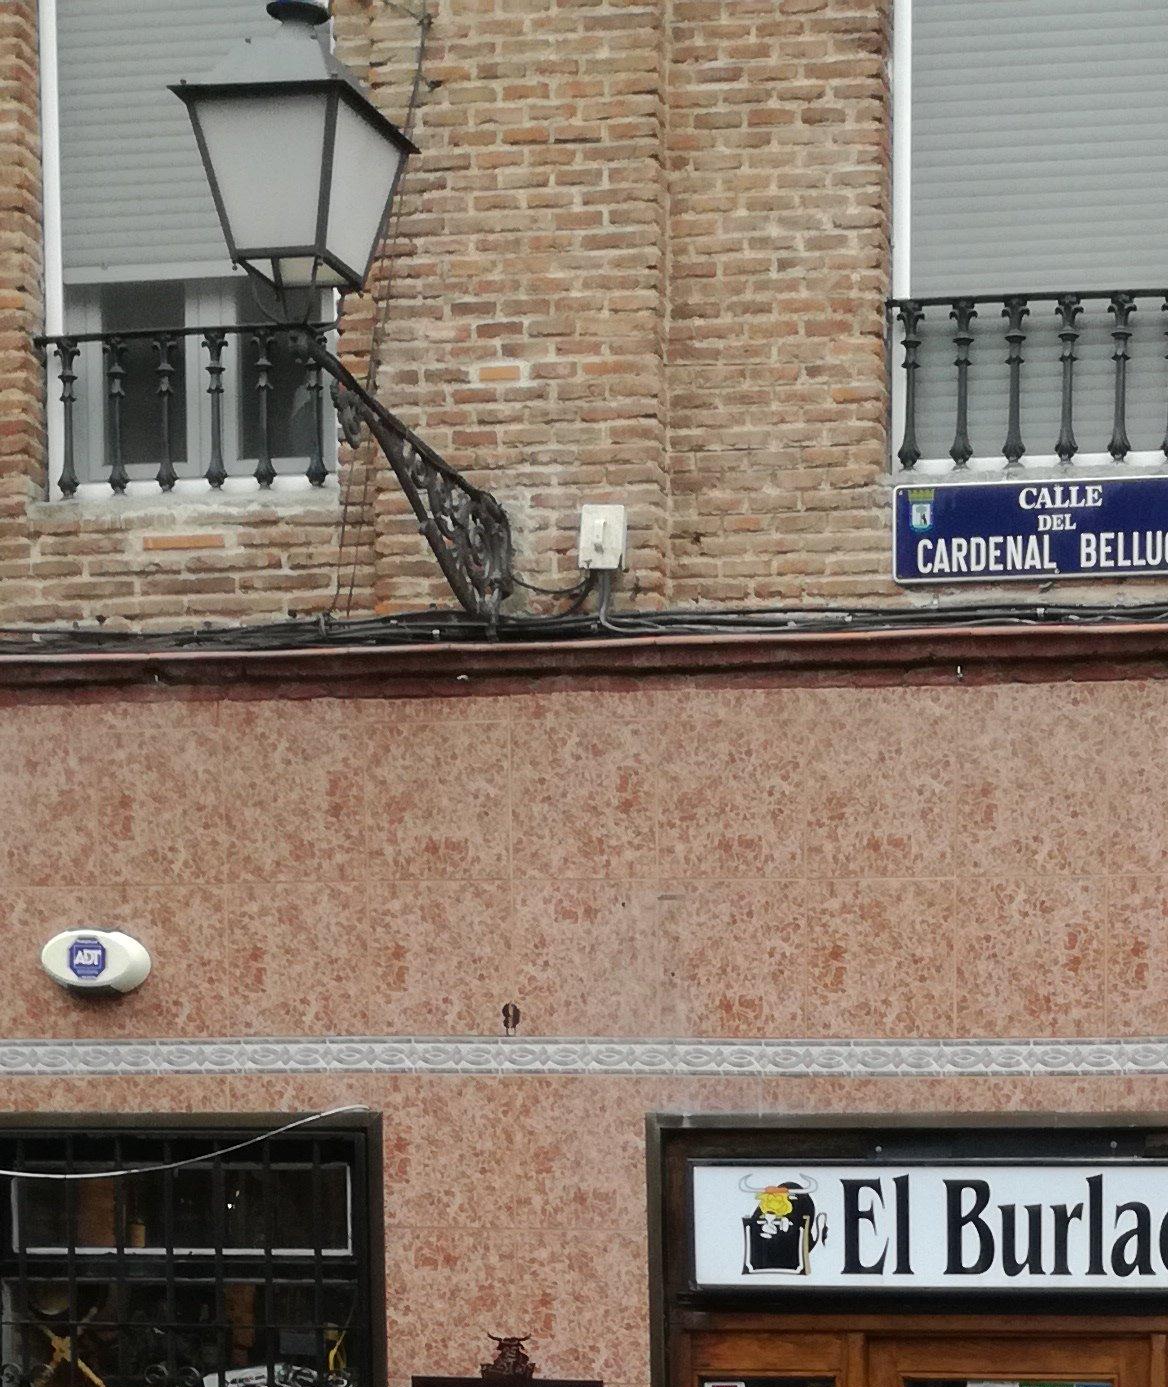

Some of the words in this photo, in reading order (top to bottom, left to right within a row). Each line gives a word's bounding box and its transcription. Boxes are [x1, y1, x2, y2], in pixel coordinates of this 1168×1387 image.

[1018, 485, 1103, 510] CALLE
[1037, 513, 1076, 532] DEL
[917, 534, 1057, 574] CARDENAL
[74, 948, 101, 966] ADT
[839, 1174, 914, 1276] El
